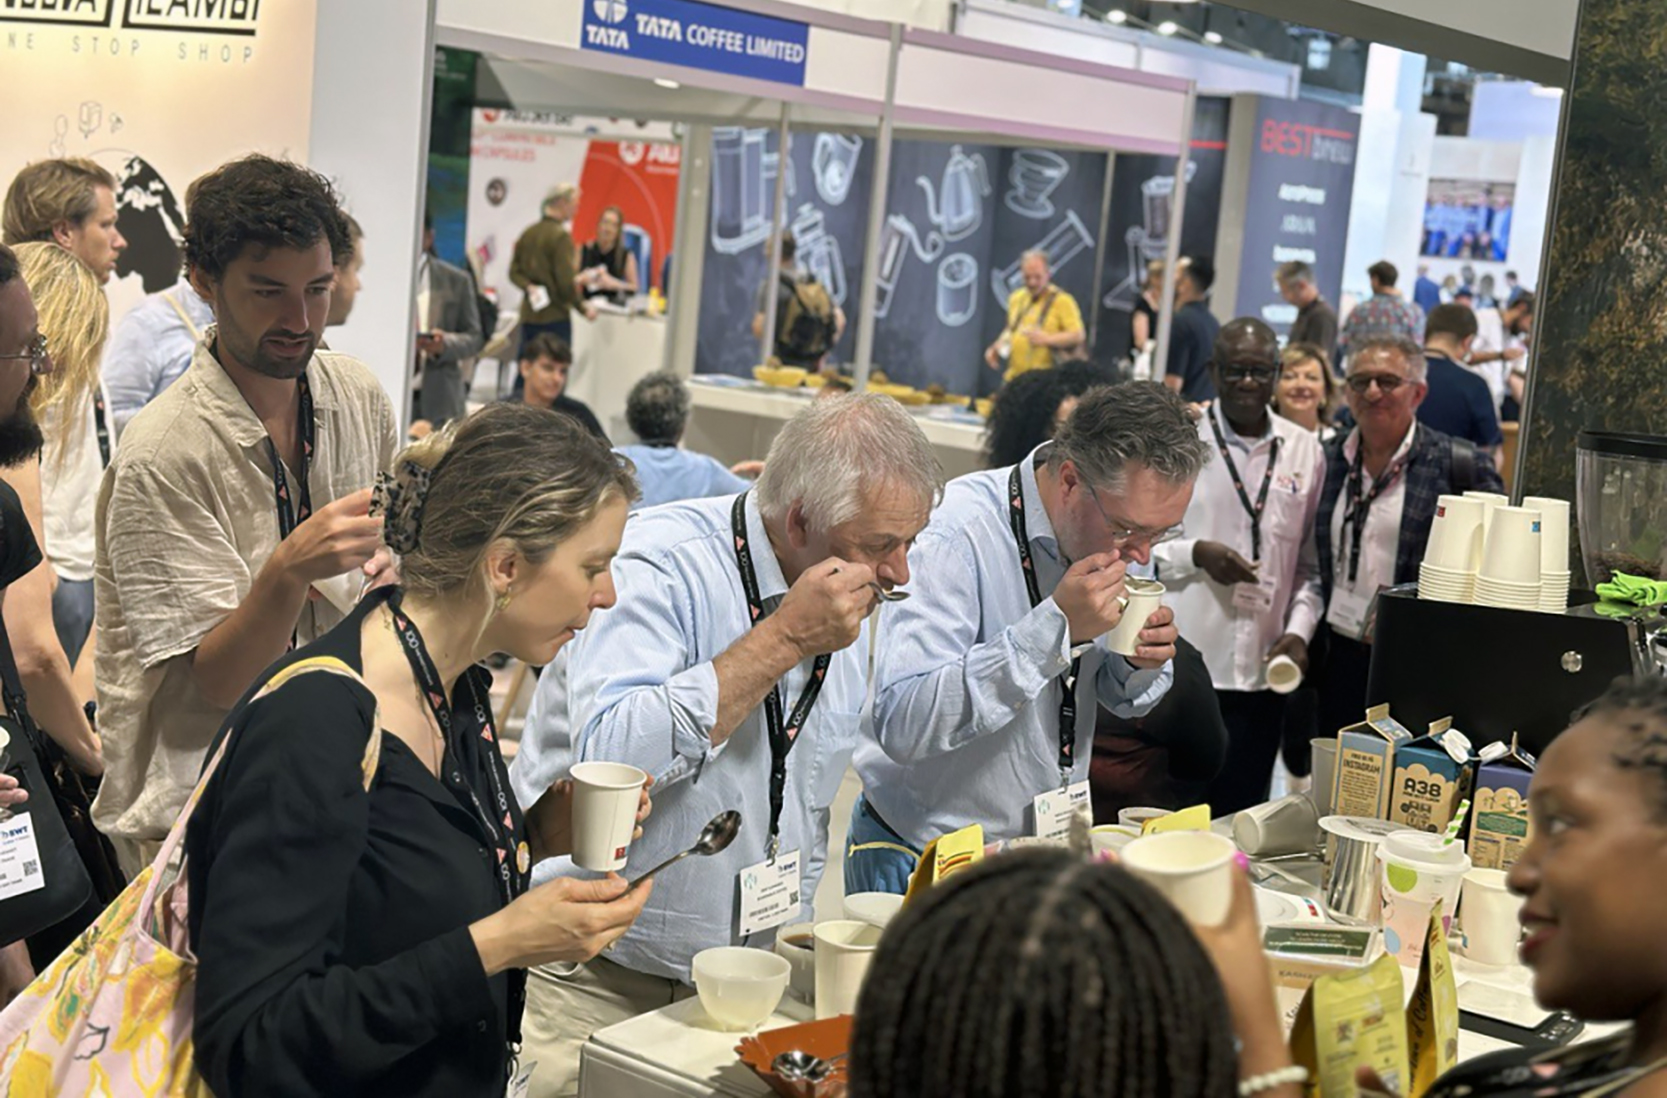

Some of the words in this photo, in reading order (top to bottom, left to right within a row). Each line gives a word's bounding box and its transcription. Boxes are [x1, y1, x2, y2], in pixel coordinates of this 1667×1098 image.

[8, 32, 34, 50] NE
[71, 35, 140, 57] STOP
[178, 42, 252, 64] SHOP
[586, 24, 630, 50] TATA
[635, 13, 682, 42] TATA
[686, 24, 744, 53] COFFEE
[746, 35, 804, 64] LIMITED
[1343, 759, 1380, 775] INSTAGRAM
[1404, 777, 1441, 798] A38
